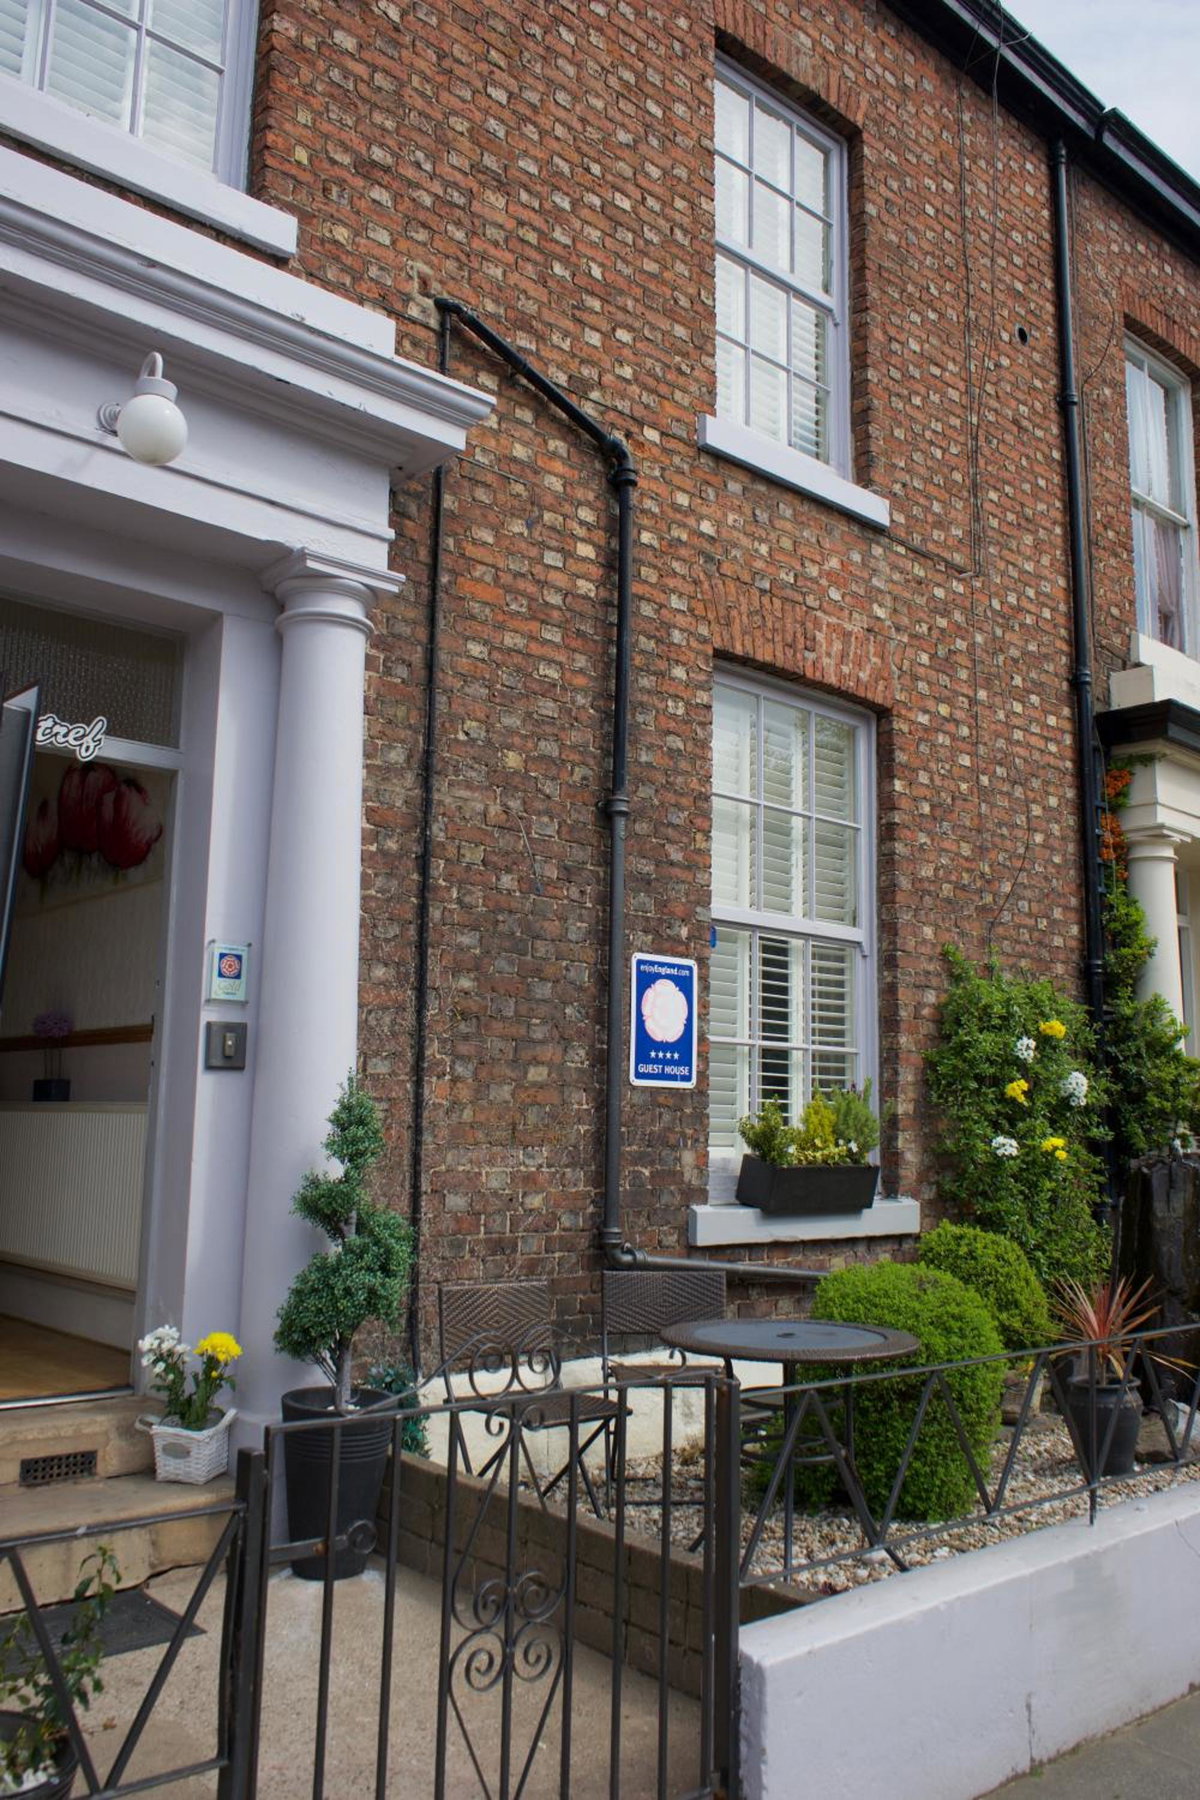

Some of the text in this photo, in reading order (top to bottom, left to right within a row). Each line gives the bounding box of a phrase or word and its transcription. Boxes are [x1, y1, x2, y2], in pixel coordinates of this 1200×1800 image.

[640, 963, 690, 977] enjoyEngland.com
[638, 1063, 690, 1076] GUEST HOUSE
